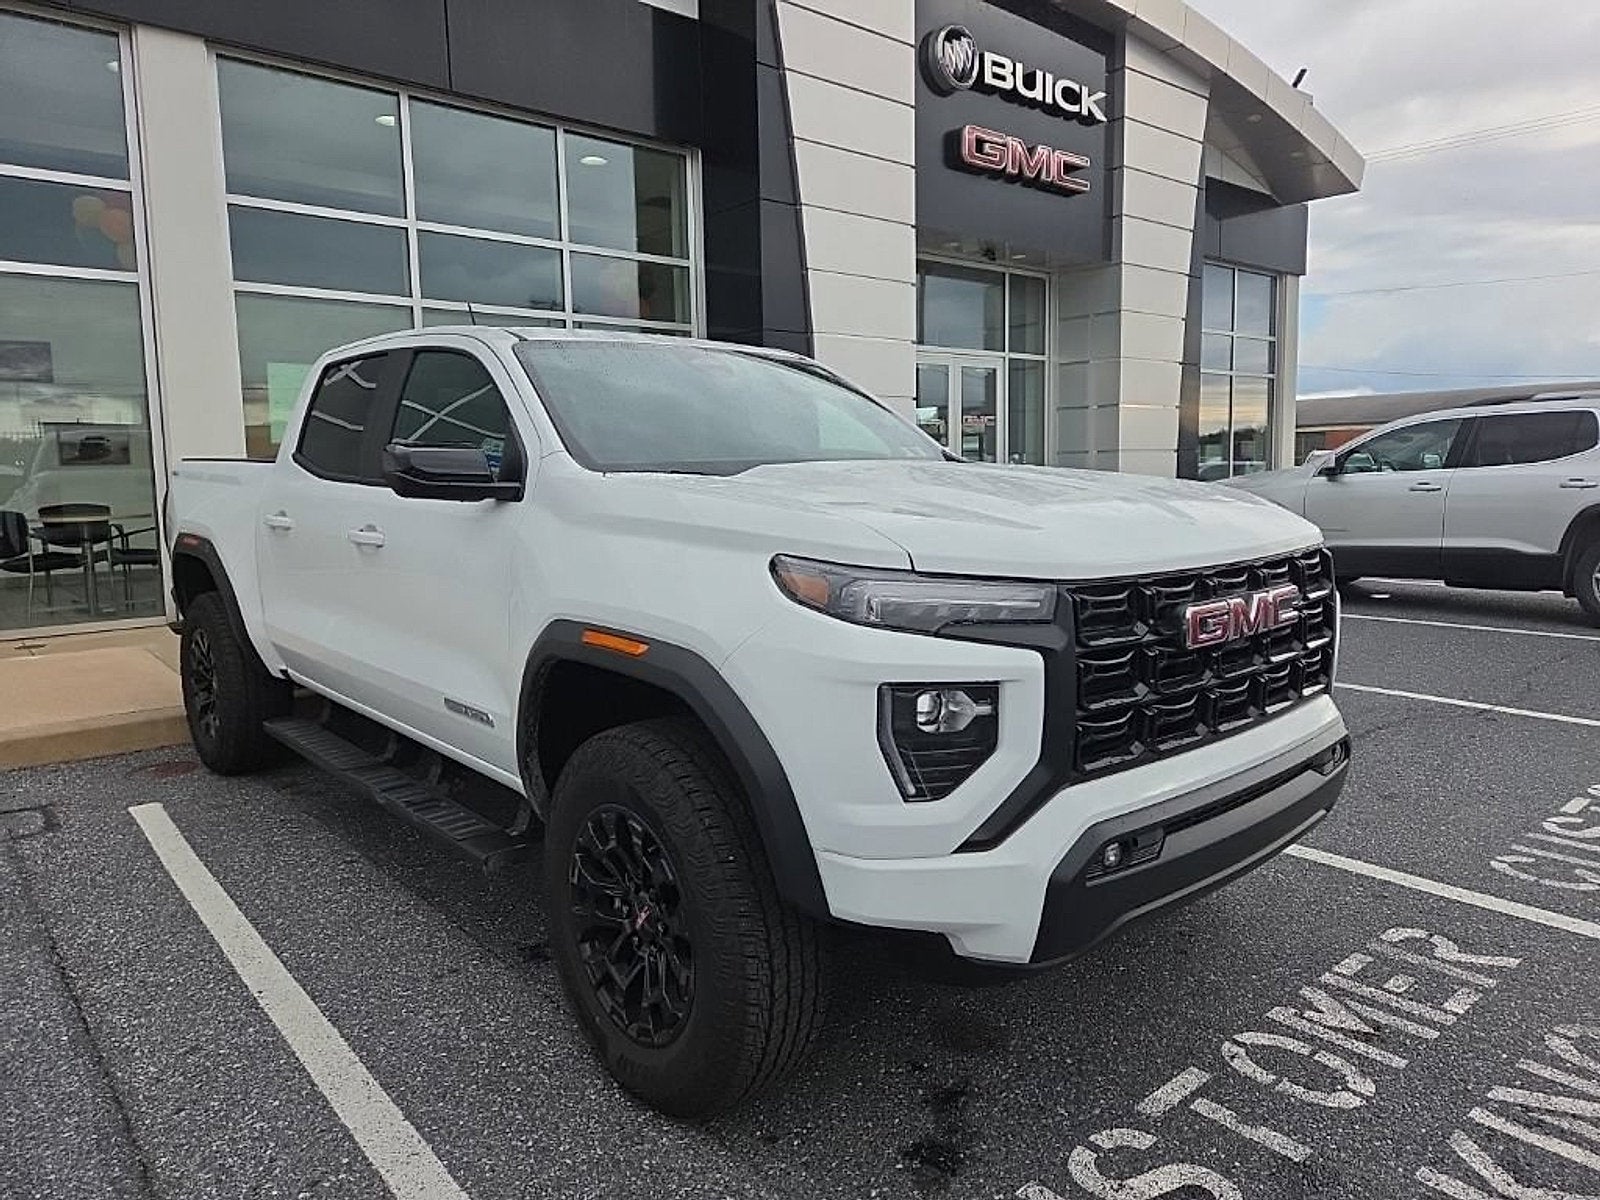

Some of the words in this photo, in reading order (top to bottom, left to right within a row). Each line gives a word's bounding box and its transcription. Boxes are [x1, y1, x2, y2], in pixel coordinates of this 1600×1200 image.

[984, 52, 1108, 122] BUICK
[962, 124, 1091, 191] GMC
[1186, 584, 1299, 650] GMC
[1015, 925, 1523, 1200] STOMER
